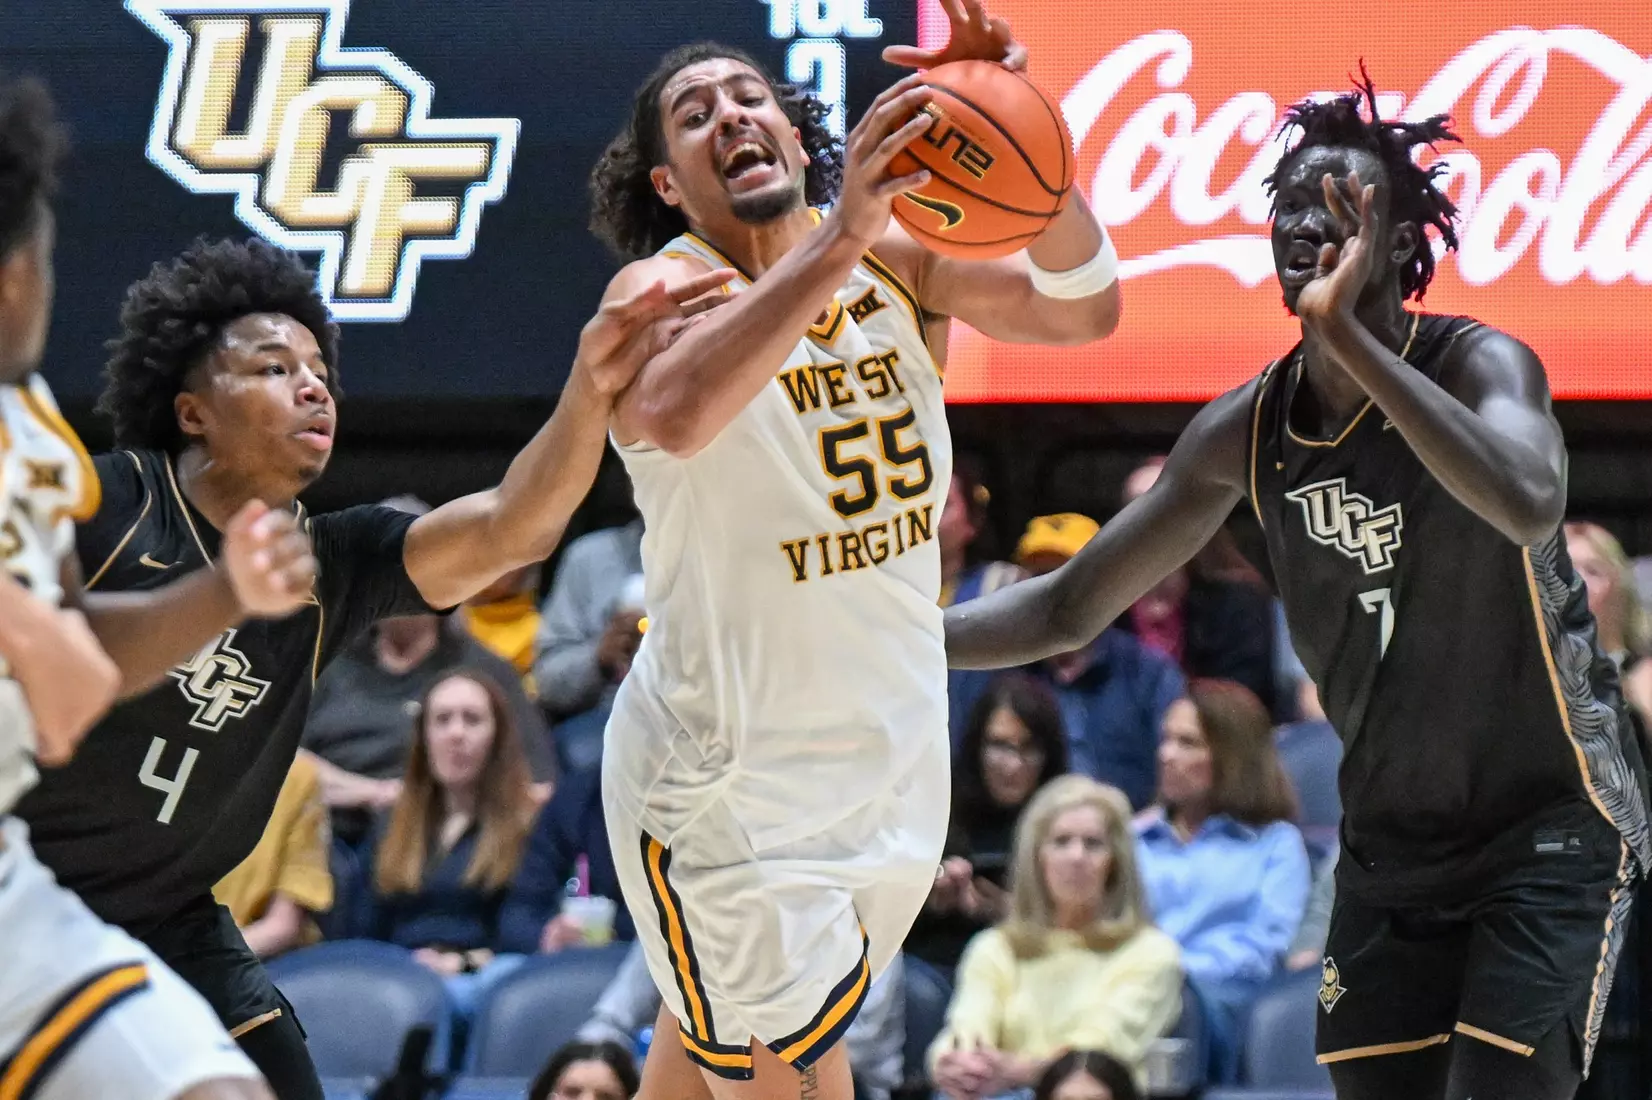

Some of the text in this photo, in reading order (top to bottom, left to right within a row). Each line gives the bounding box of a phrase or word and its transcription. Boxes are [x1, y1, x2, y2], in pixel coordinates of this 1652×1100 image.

[168, 10, 496, 302] UCF
[910, 106, 996, 181] LITE
[1060, 24, 1652, 286] CocCol
[777, 347, 906, 416] WEST
[818, 406, 935, 521] 55
[780, 502, 936, 584] VIRGIN
[1300, 482, 1399, 570] UCF
[1358, 588, 1395, 661] 7
[139, 736, 199, 824] 4
